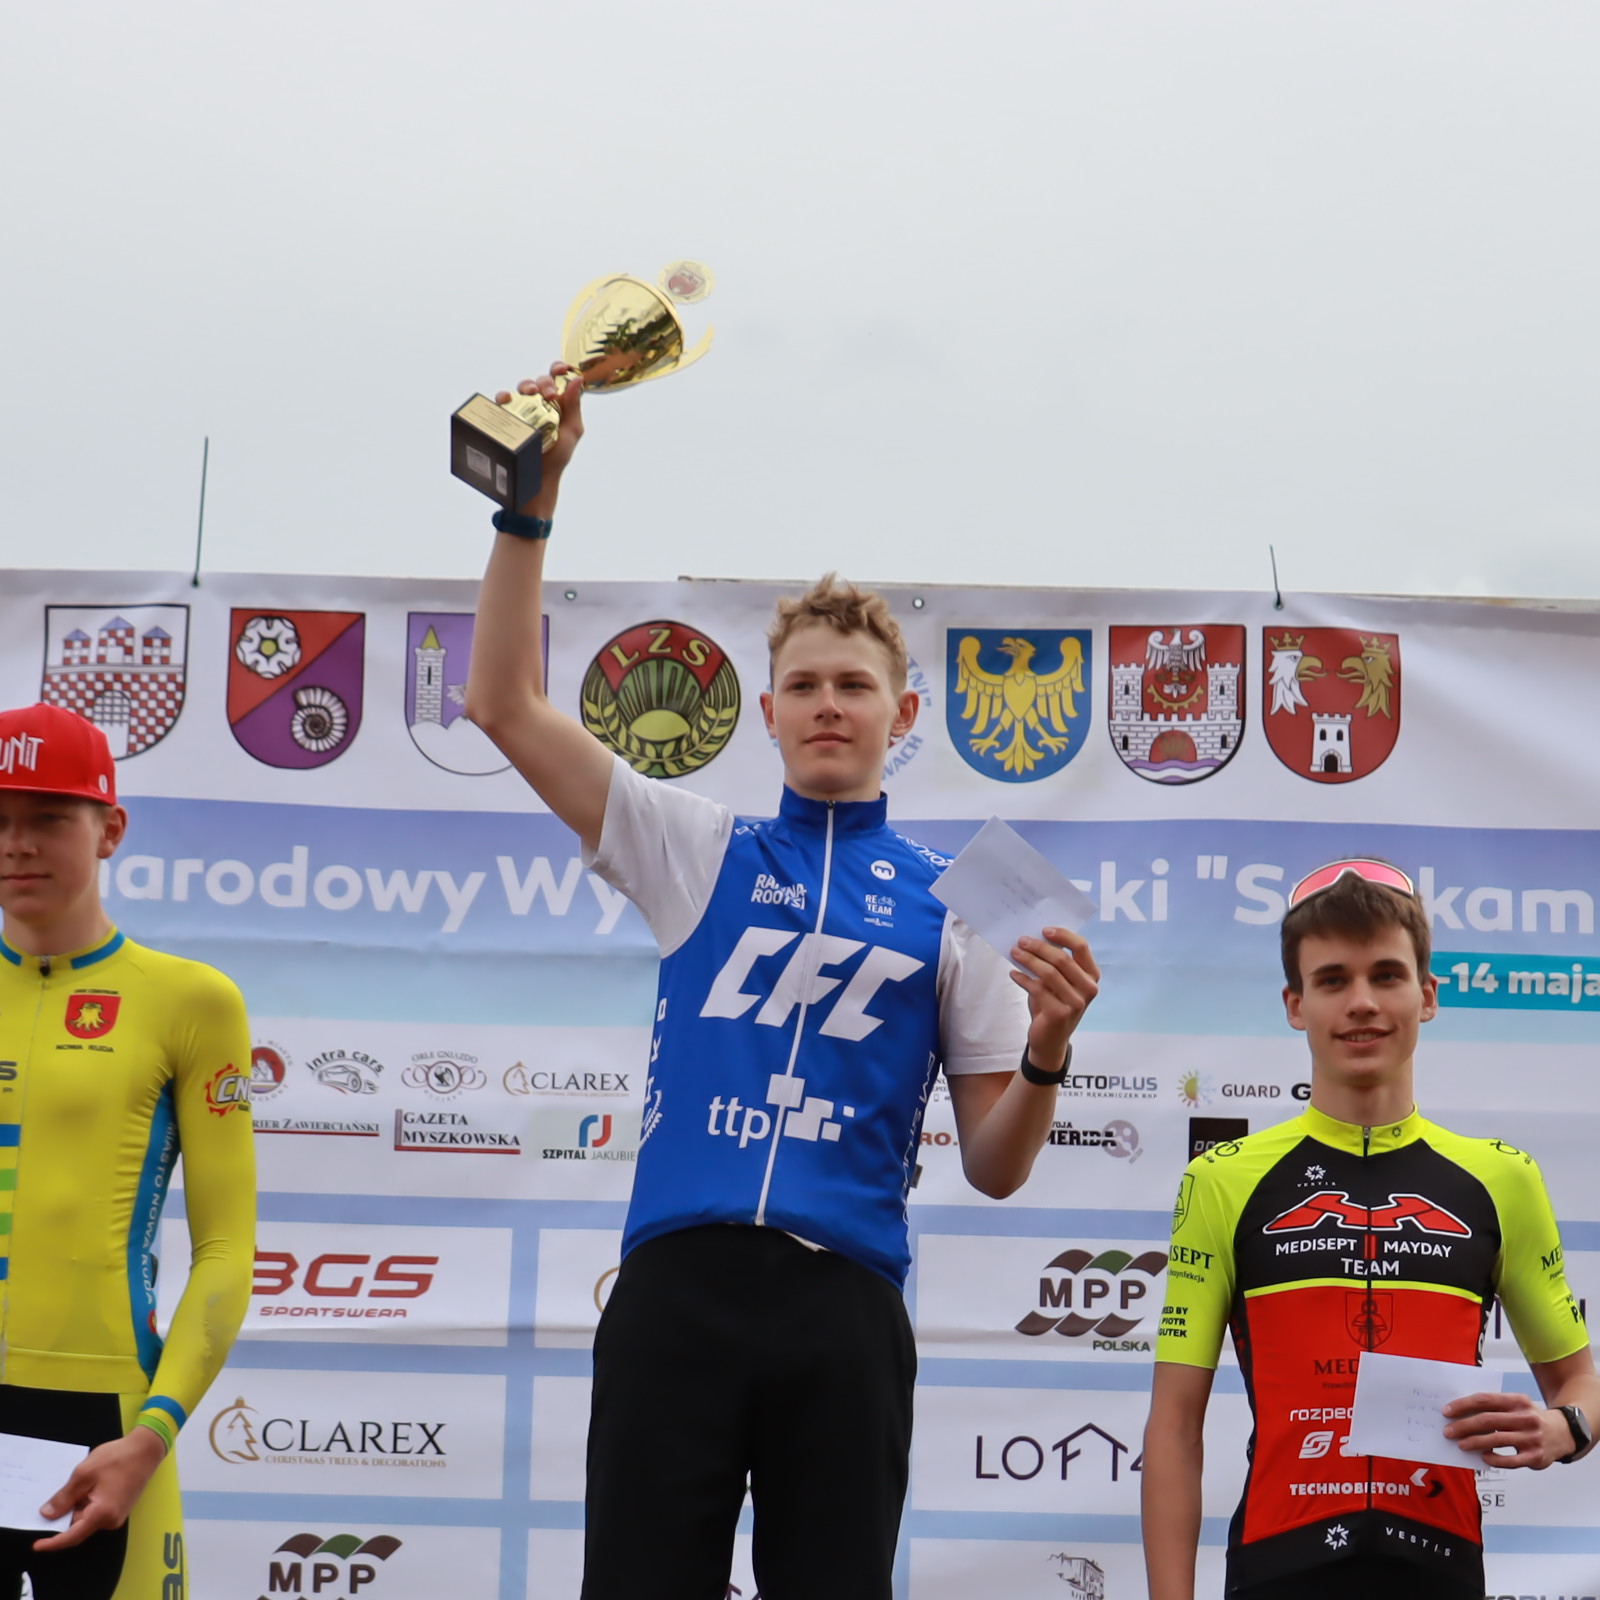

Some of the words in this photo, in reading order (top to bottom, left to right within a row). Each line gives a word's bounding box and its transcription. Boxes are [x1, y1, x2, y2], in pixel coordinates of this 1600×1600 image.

[610, 628, 711, 670] LZS
[866, 903, 893, 916] TEAM
[1437, 963, 1499, 994] -14
[304, 1049, 346, 1072] intra
[352, 1050, 385, 1073] cars
[530, 1071, 630, 1092] CLAREX
[1061, 1074, 1158, 1092] ECTOPLUS
[1221, 1083, 1281, 1099] GUARD
[252, 1119, 281, 1130] RIER
[282, 1118, 380, 1132] ZAWIERCIAŃSKI
[403, 1111, 469, 1126] GAZETA
[706, 1094, 772, 1149] ttp
[402, 1130, 521, 1147] MYSZKOWSKA
[542, 1148, 587, 1160] SZPITAL
[590, 1150, 636, 1162] JAKUBIE
[1275, 1237, 1357, 1256] MEDISEPT
[1383, 1239, 1453, 1259] MAYDAY
[1340, 1257, 1400, 1276] TEAM
[1038, 1277, 1147, 1311] MPP
[259, 1305, 408, 1319] SPORTSWEAR
[1176, 1306, 1189, 1315] BY
[1092, 1340, 1151, 1353] POLSKA
[261, 1418, 448, 1456] CLAREX
[264, 1454, 326, 1466] CHRISTMAS
[328, 1456, 359, 1466] TREES
[975, 1422, 1143, 1481] LOFT
[1289, 1481, 1410, 1497] TECHNOBETON
[1385, 1526, 1452, 1557] VESTIS
[268, 1561, 376, 1595] MPP
